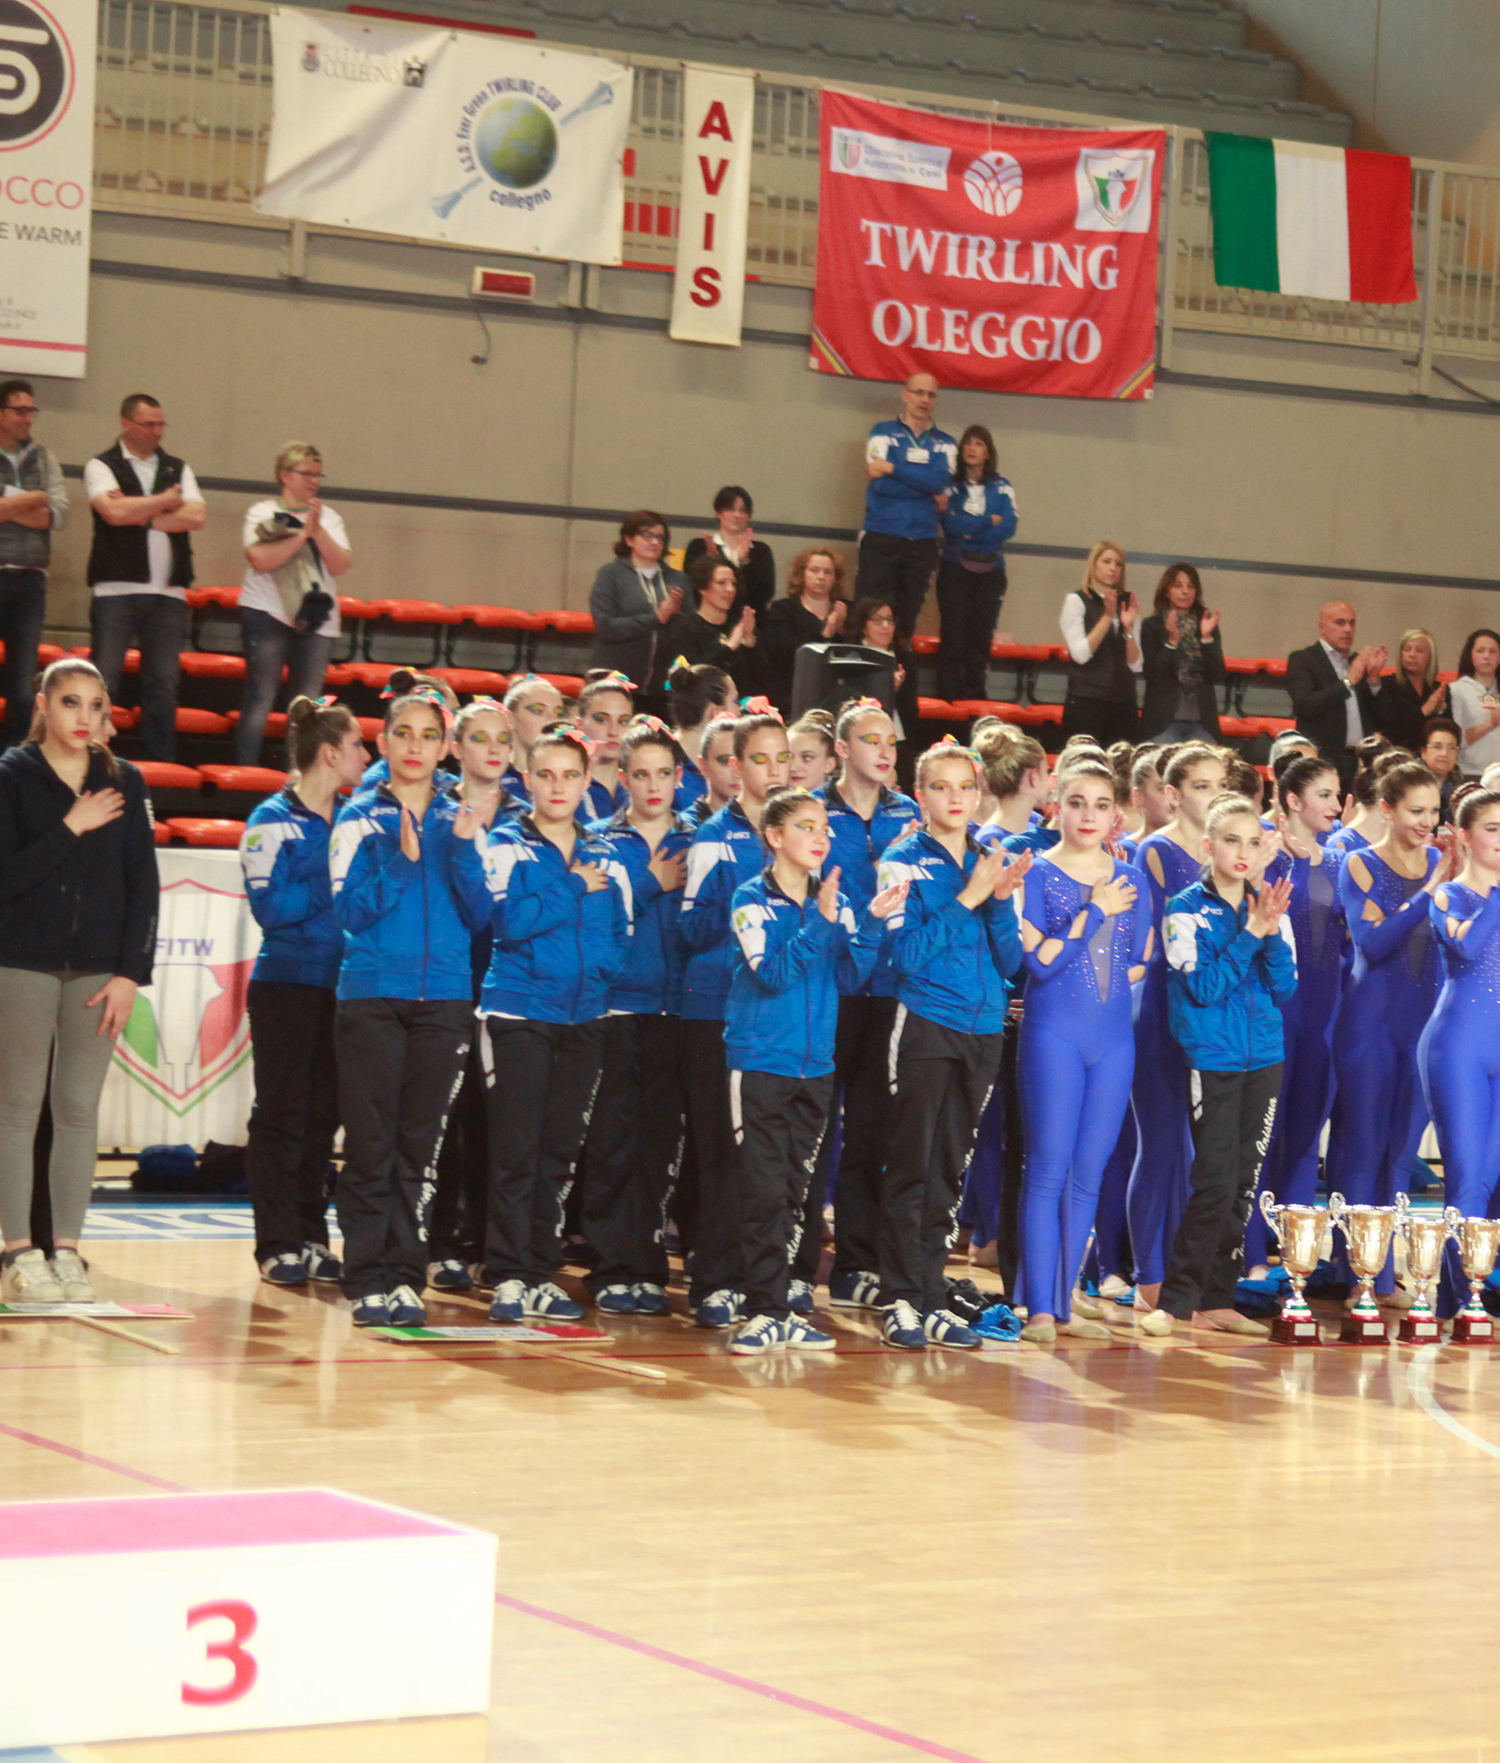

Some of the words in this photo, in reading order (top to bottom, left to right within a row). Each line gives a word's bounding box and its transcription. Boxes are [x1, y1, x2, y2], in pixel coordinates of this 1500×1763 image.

[485, 76, 537, 96] TWIRLING
[0, 175, 84, 210] CCO
[689, 100, 734, 308] AVIS
[14, 223, 83, 247] WARM
[860, 217, 1120, 291] TWIRLING
[871, 299, 1102, 364] OLEGGIO
[156, 937, 216, 957] FITW
[181, 1598, 259, 1708] 3
